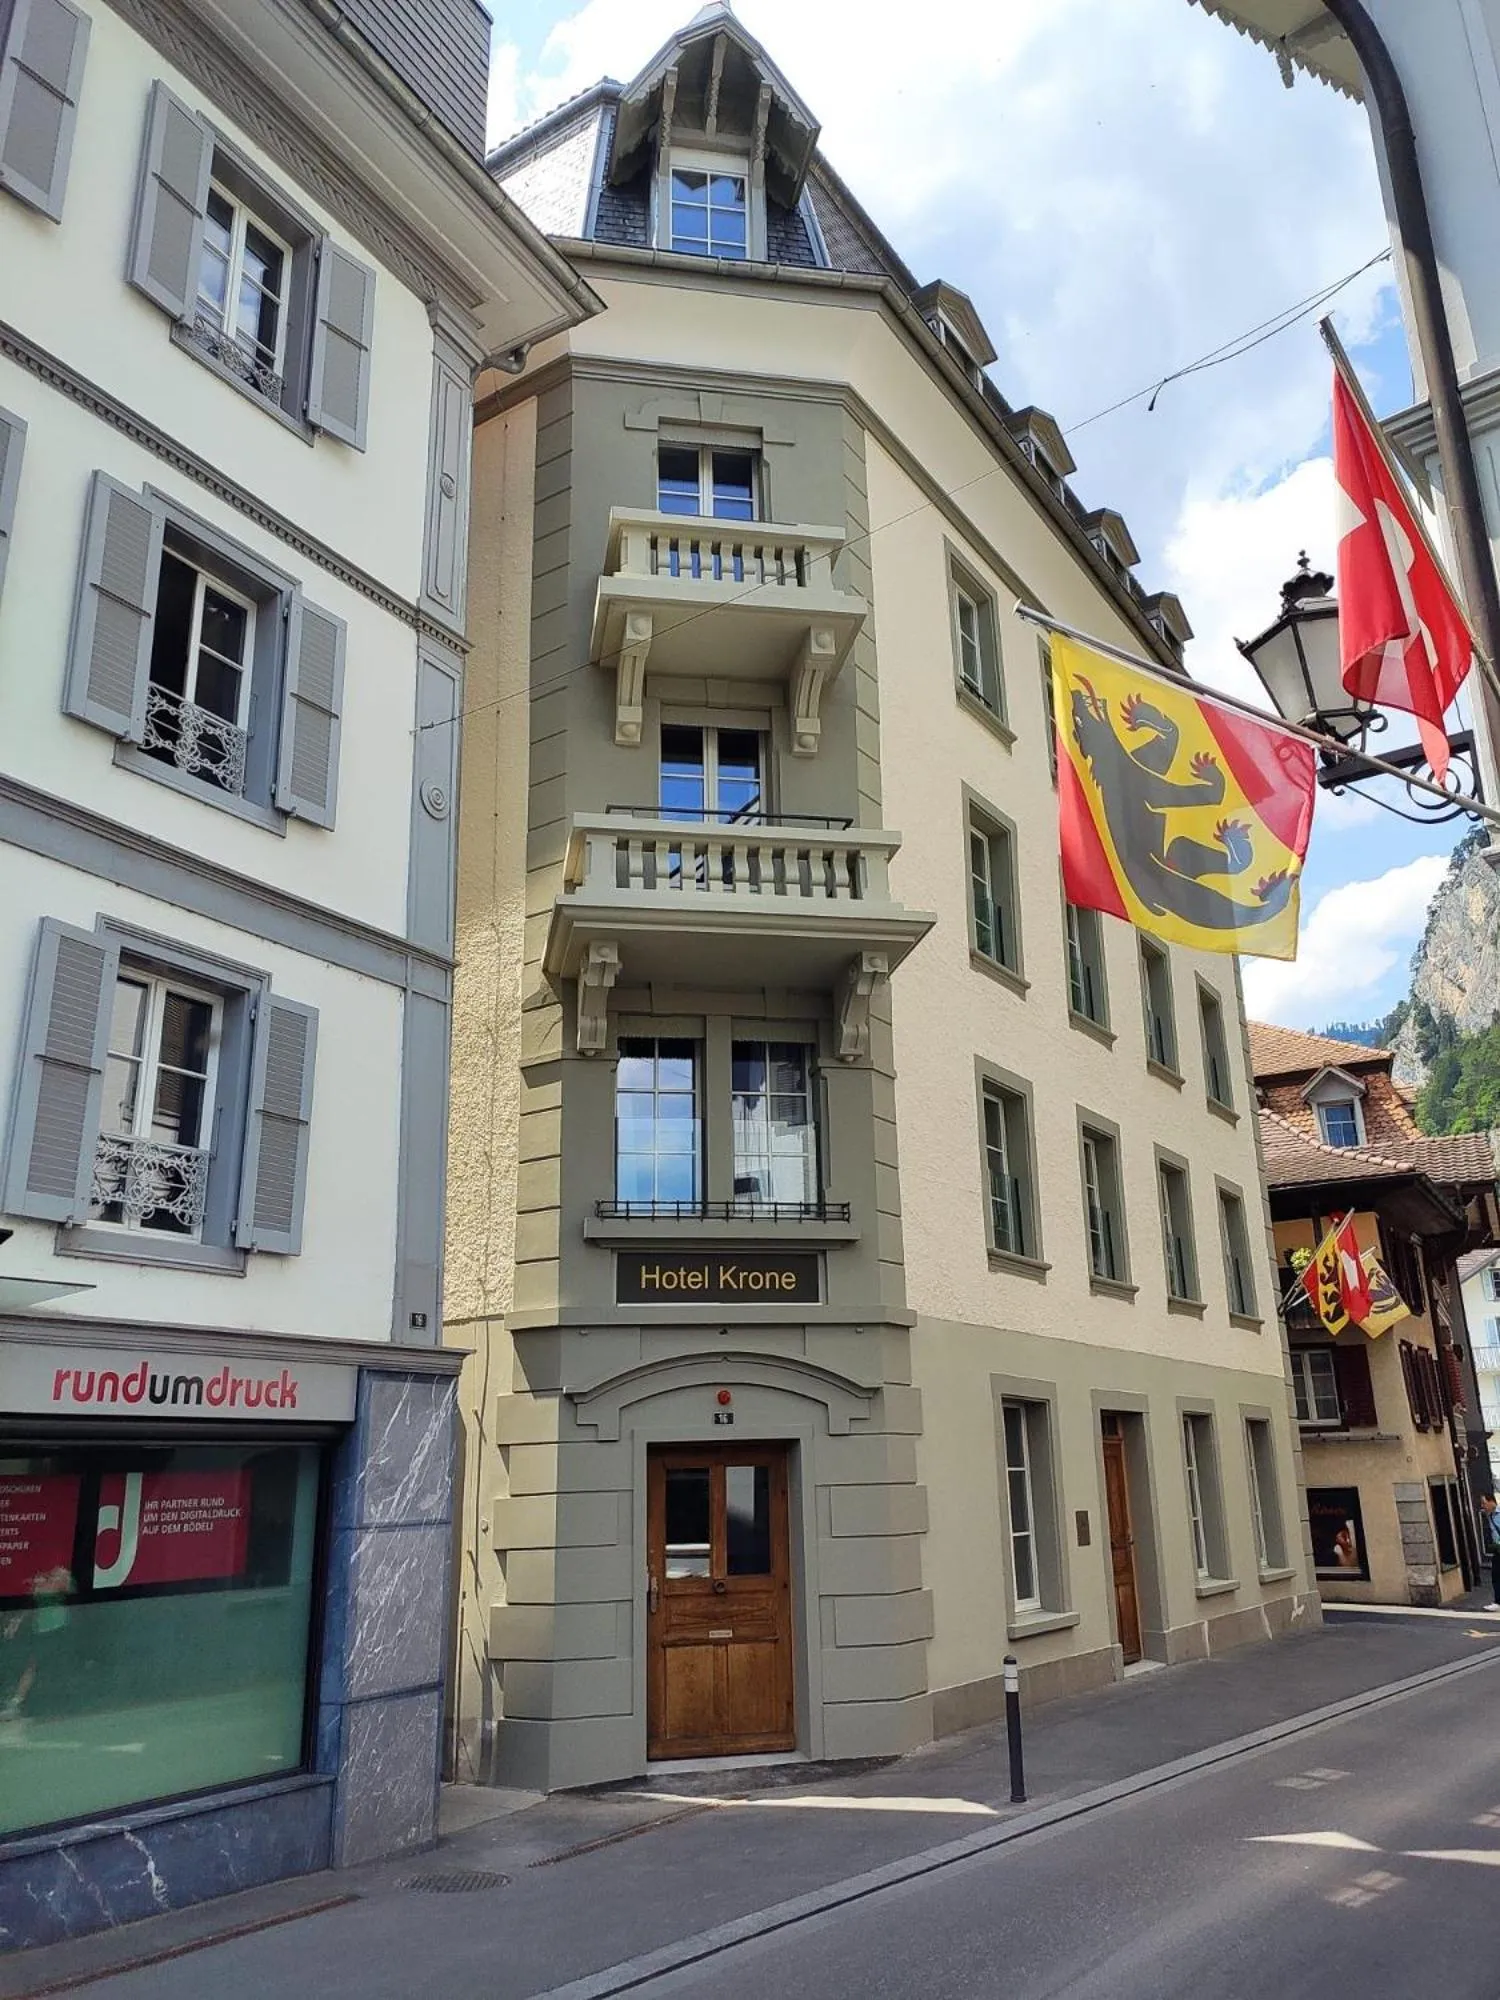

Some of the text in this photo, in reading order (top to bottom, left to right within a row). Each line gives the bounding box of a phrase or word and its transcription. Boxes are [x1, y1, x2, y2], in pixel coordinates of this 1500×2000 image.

[640, 1264, 797, 1290] Hotel Krone
[52, 1361, 298, 1409] rundumdruck
[144, 1497, 225, 1510] IHR PARTNER RUND
[143, 1508, 242, 1522] UM DEN DIGITALDRUCK
[142, 1525, 160, 1535] AUF
[160, 1523, 181, 1534] DEM
